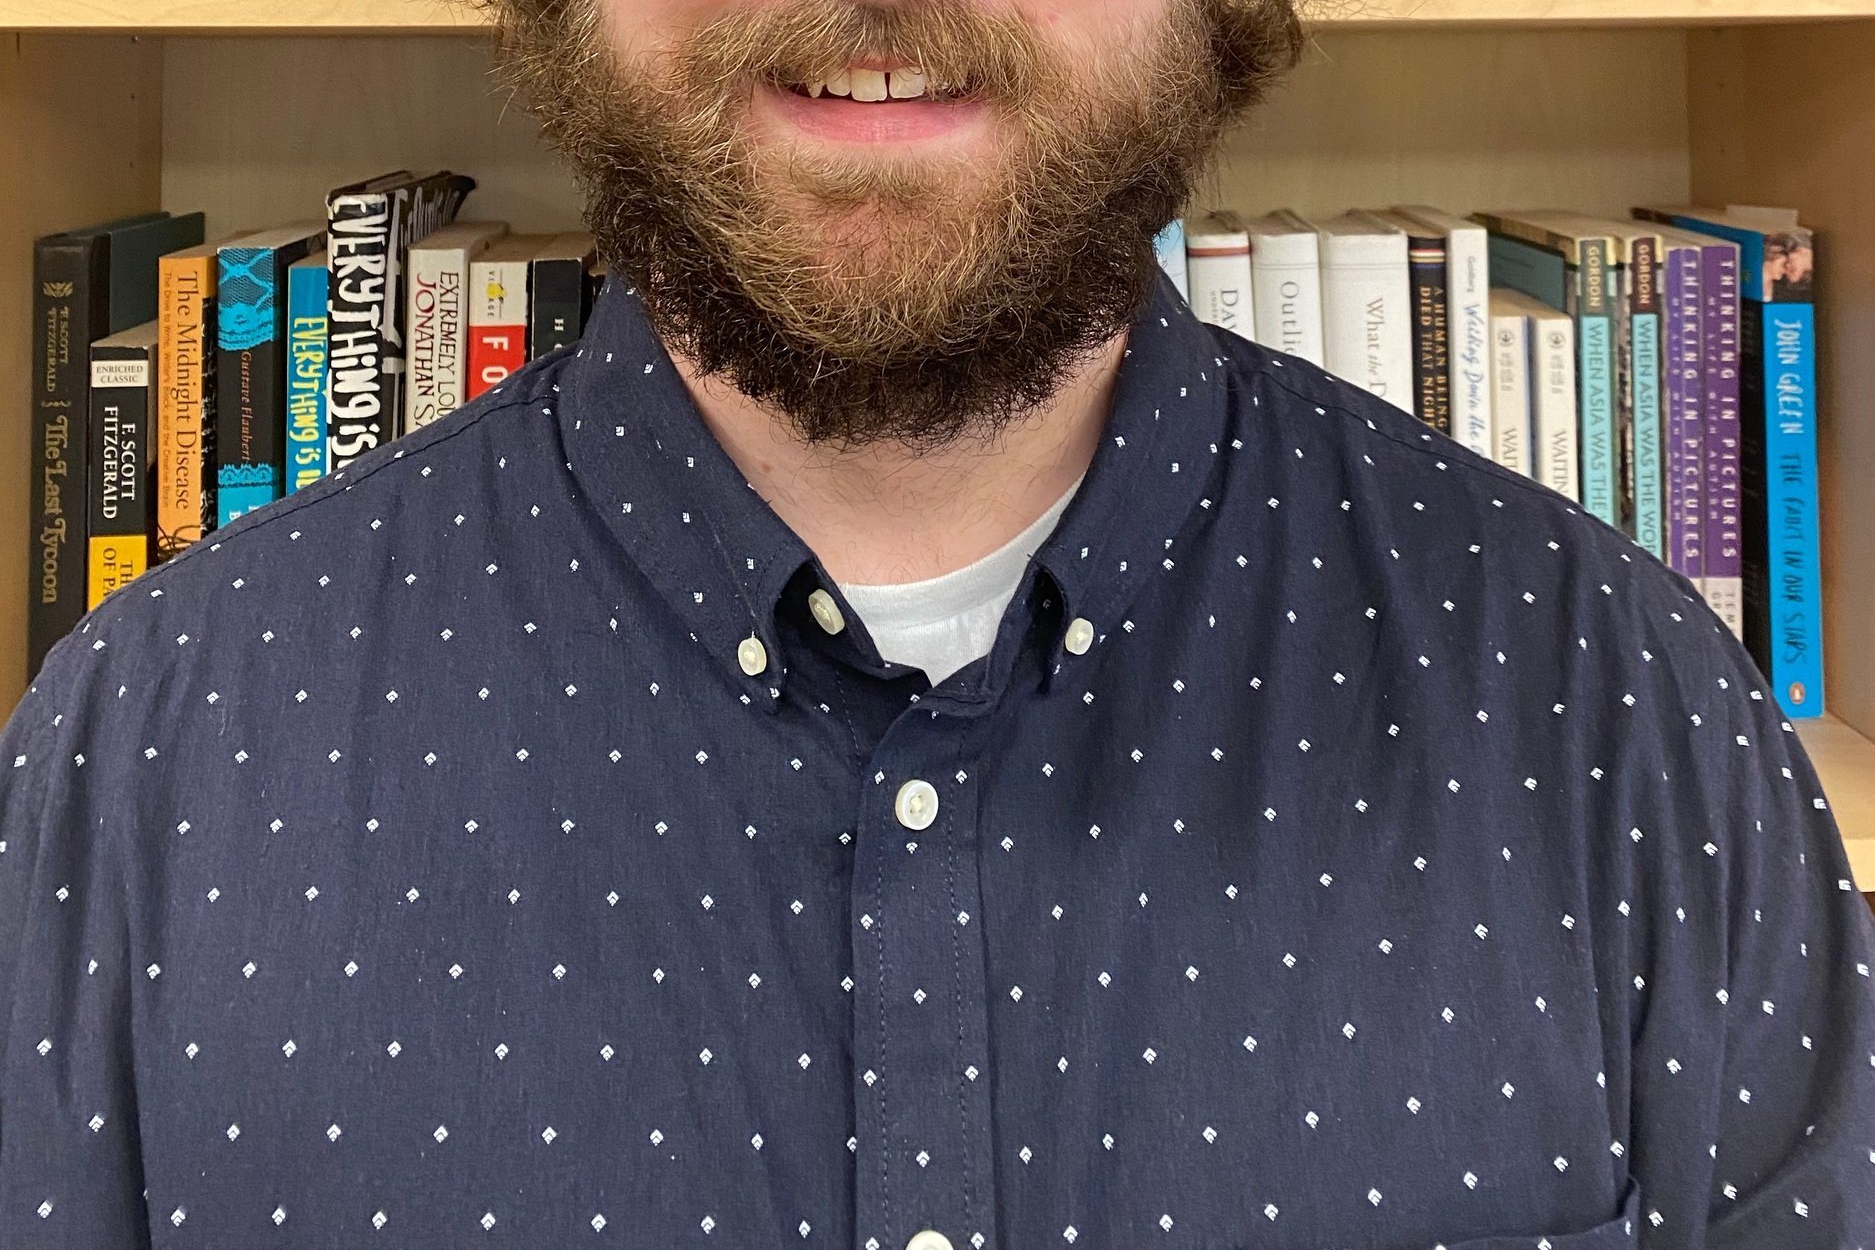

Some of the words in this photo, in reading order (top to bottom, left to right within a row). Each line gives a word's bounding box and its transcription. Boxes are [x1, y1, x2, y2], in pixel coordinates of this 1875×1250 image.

[177, 271, 198, 315] The
[1433, 286, 1445, 296] A
[1587, 246, 1602, 307] GORDON
[1638, 243, 1652, 304] GORDON
[438, 271, 459, 377] EXTREMELY
[1366, 297, 1385, 349] What
[1420, 286, 1433, 326] DIED
[1682, 260, 1700, 381] THINKING
[1719, 260, 1736, 381] THINKING
[414, 272, 437, 397] JONATHAN
[1421, 334, 1434, 370] THAT
[1434, 303, 1447, 367] HUMAN
[1462, 302, 1485, 365] Writing
[1587, 323, 1604, 382] WHEN
[1637, 320, 1654, 380] WHEN
[1774, 318, 1802, 366] JOHN
[96, 365, 143, 374] ENRICHED
[101, 375, 138, 384] CLASSIC
[171, 324, 198, 422] Midnight
[239, 352, 253, 403] Gustave
[1367, 354, 1383, 374] the
[1436, 375, 1448, 428] BEING
[1465, 372, 1485, 411] Down
[1588, 384, 1604, 425] ASIA
[1638, 381, 1654, 422] ASIA
[1683, 396, 1700, 421] IN
[1720, 396, 1736, 421] IN
[1779, 371, 1804, 434] GREEN
[44, 414, 70, 458] The
[120, 423, 136, 437] F.
[240, 406, 254, 461] Flaubert
[1469, 413, 1486, 440] the
[1589, 429, 1606, 471] WAS
[1639, 424, 1656, 467] WAS
[102, 406, 118, 518] FITZGERALD
[121, 441, 136, 500] SCOTT
[175, 431, 197, 509] Disease
[1781, 451, 1802, 489] THE
[44, 460, 70, 516] Last
[1590, 474, 1607, 510] THE
[1640, 470, 1657, 504] THE
[1683, 437, 1701, 559] PICTURES
[1720, 437, 1738, 559] PICTURES
[1780, 496, 1804, 543] FAULT
[41, 516, 67, 604] Tycoon
[102, 548, 117, 571] OF
[1783, 548, 1806, 570] IN
[1783, 573, 1807, 604] OUR
[1783, 611, 1809, 664] STARS
